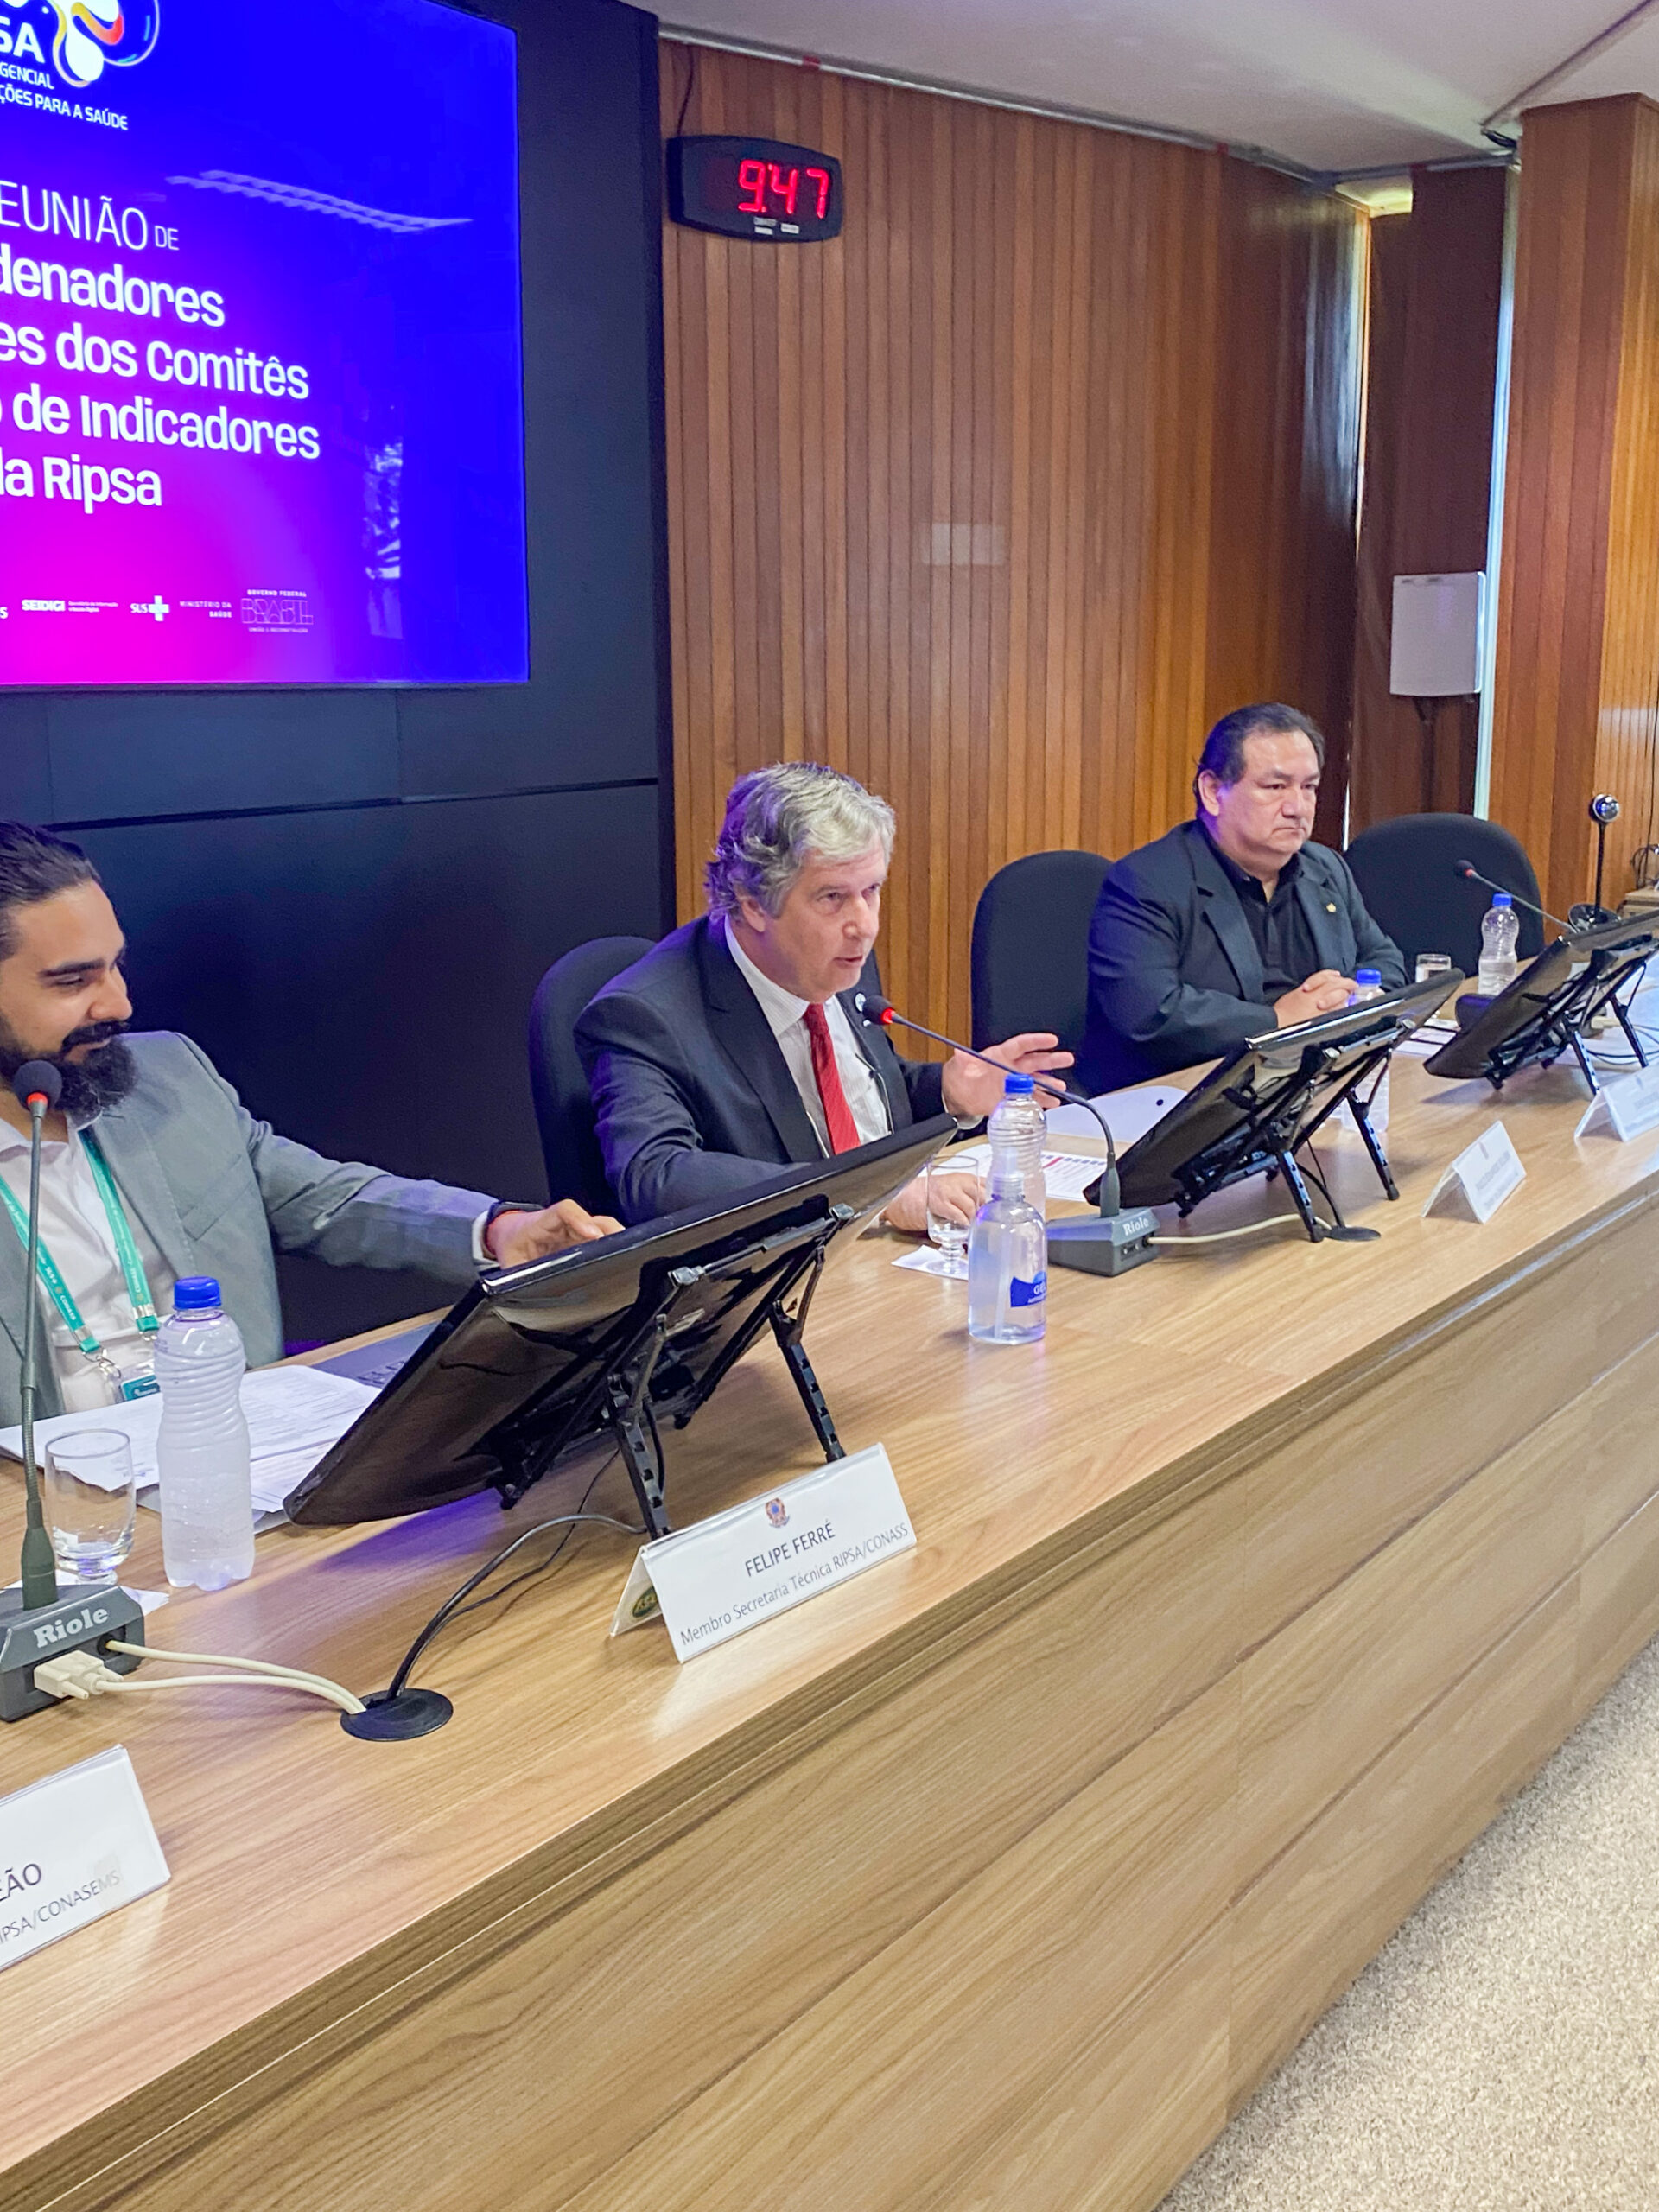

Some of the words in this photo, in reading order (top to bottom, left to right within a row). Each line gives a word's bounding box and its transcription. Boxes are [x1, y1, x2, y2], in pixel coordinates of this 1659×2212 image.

[0, 62, 55, 90] GENCIAL
[35, 93, 71, 117] PARA
[73, 104, 83, 119] A
[86, 108, 128, 130] SAÚDE
[0, 180, 148, 251] EUNIÃO
[154, 225, 180, 251] DE
[55, 322, 138, 377] dos
[146, 340, 309, 399] Comitês
[12, 383, 70, 434] de
[80, 395, 321, 459] Indicadores
[43, 454, 162, 514] Ripsa
[179, 600, 220, 608] MINISTÉRIO
[241, 598, 314, 625] BRASIL
[1122, 1217, 1149, 1236] Riole
[745, 1542, 791, 1577] FELIPE
[792, 1518, 836, 1554] FERRÉ
[680, 1612, 732, 1645] Membro
[733, 1583, 790, 1619] Secretaria
[790, 1563, 833, 1591] Técnica
[832, 1522, 909, 1571] RIPSA/CONASS
[33, 1608, 109, 1648] Riole
